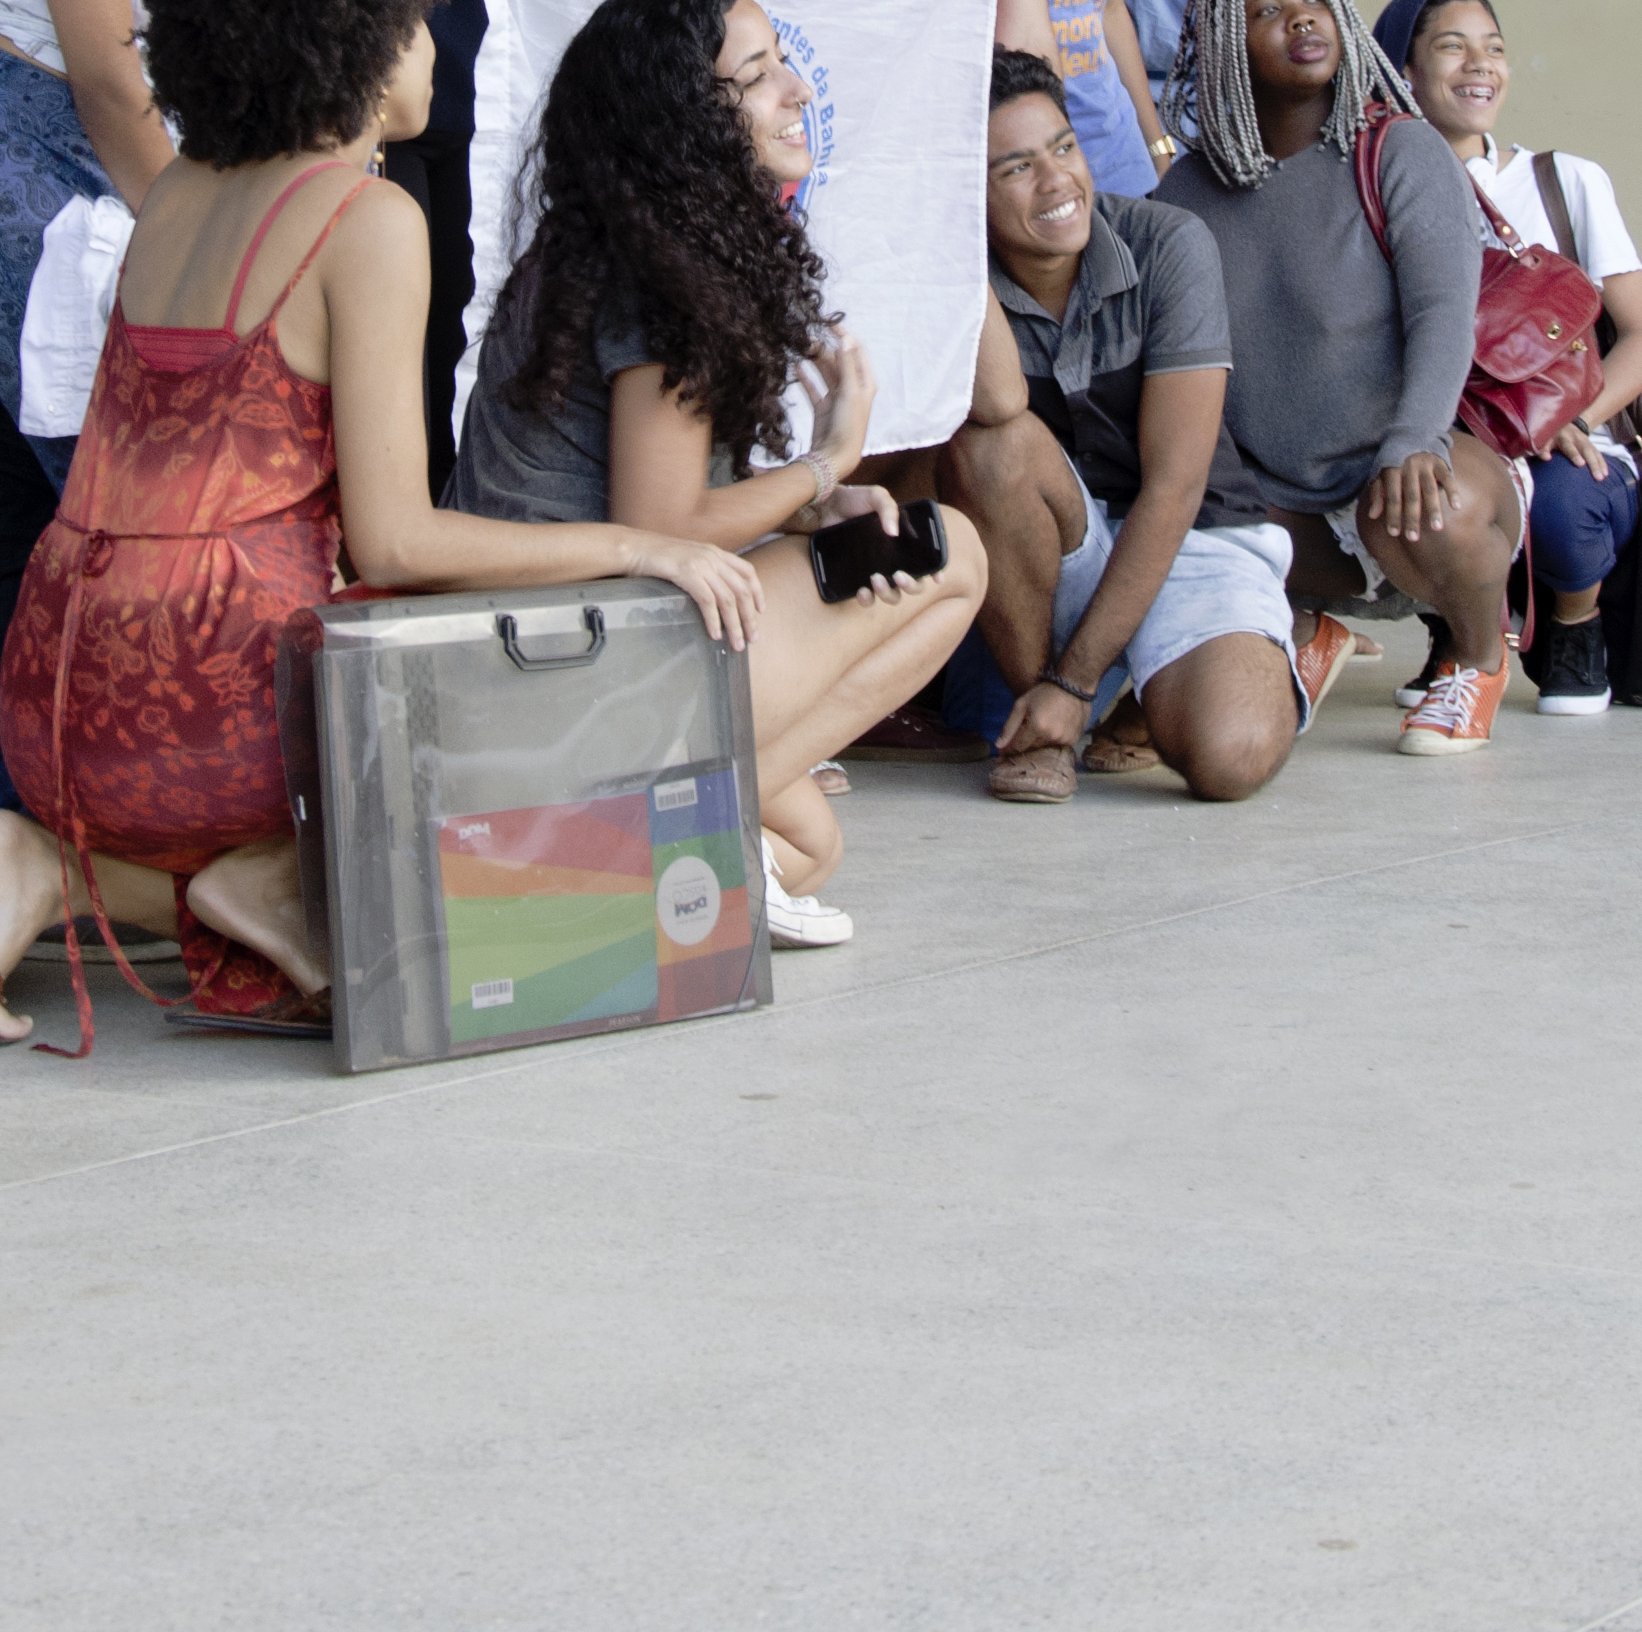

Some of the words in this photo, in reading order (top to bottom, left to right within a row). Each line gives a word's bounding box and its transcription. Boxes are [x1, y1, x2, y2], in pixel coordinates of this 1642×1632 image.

[768, 11, 815, 65] antes
[811, 66, 829, 101] da
[817, 103, 835, 187] Bahia
